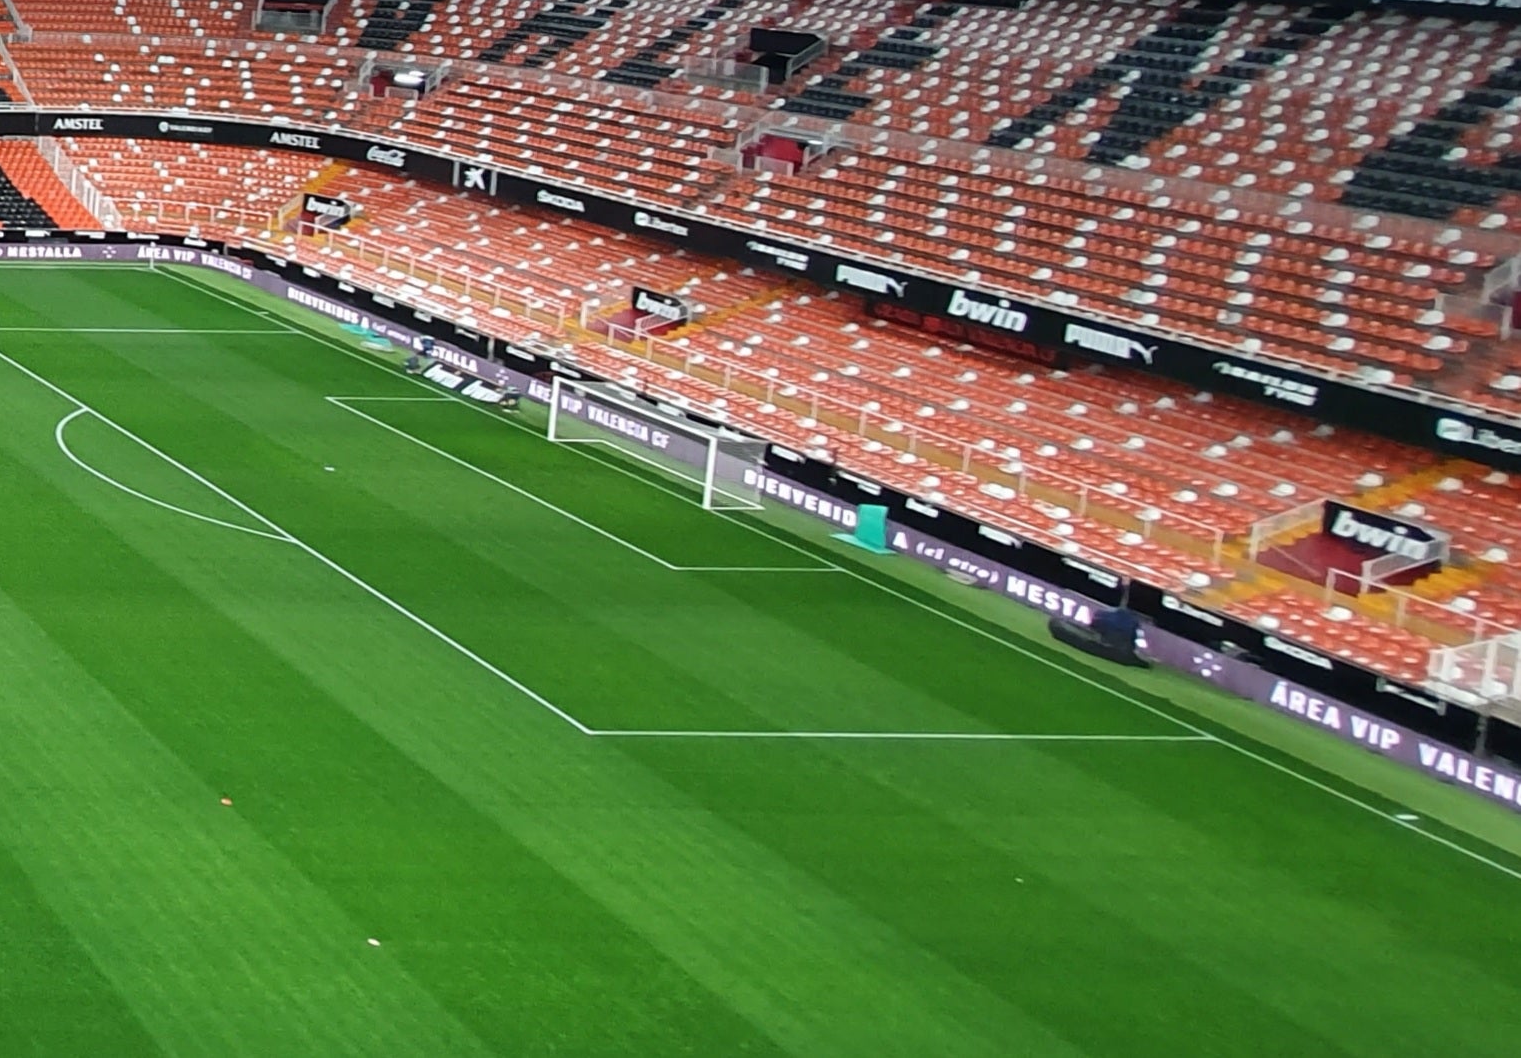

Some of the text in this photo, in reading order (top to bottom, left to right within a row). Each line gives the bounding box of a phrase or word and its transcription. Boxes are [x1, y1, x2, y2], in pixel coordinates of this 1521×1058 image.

[53, 118, 104, 130] AMSTEL
[270, 132, 321, 150] AMSTEL
[307, 196, 346, 217] bwin
[7, 245, 83, 259] MESTALLA
[137, 244, 170, 259] ÁREA
[174, 250, 196, 263] VIP
[200, 252, 243, 277] VALENCIA
[288, 286, 360, 325] BIENVENIDOS
[360, 316, 371, 329] A
[946, 289, 1028, 333] bwin
[560, 394, 583, 414] VIP
[587, 404, 649, 443] VALENCIA
[650, 430, 671, 450] CF
[744, 468, 858, 529] BIENVENID
[892, 530, 909, 551] A
[948, 553, 1000, 585] otro)
[1331, 510, 1430, 560] bwin
[1270, 679, 1343, 730] ÁREA
[1349, 713, 1401, 751] VIP
